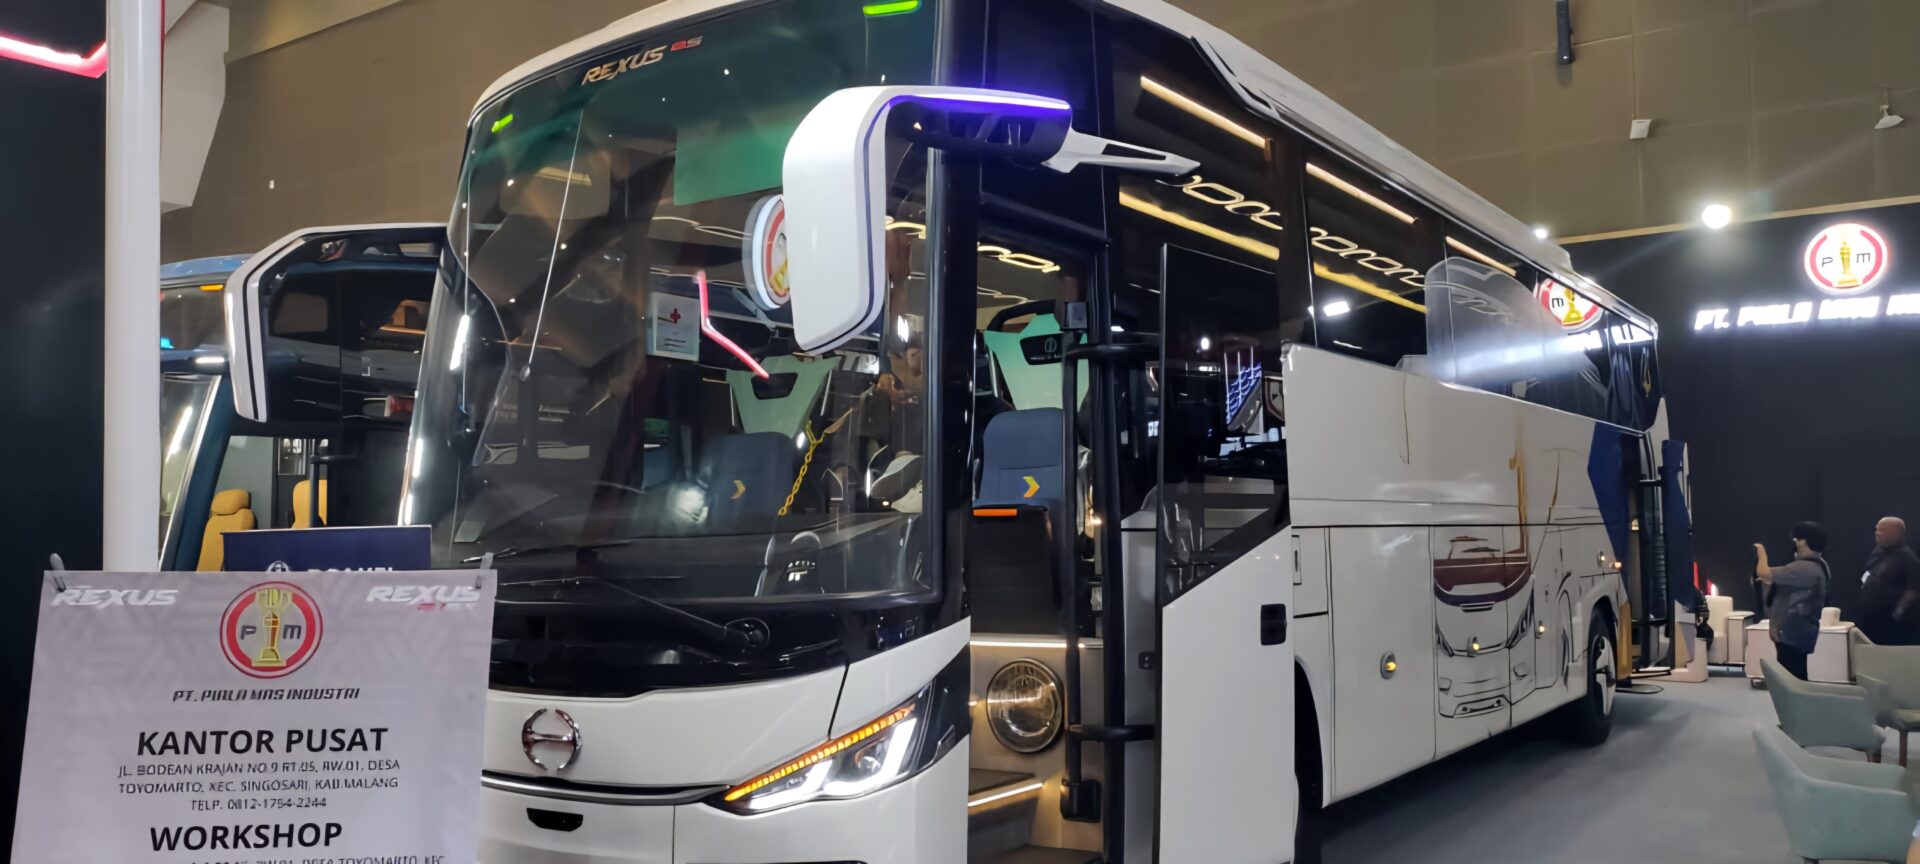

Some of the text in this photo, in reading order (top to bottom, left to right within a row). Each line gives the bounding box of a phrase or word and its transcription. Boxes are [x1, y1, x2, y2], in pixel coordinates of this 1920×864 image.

[581, 45, 668, 86] REXUS
[51, 589, 179, 609] REXUS
[366, 585, 481, 606] REXUS
[240, 625, 256, 640] P
[173, 690, 198, 702] PT.
[286, 688, 360, 700] INDUSTRI
[137, 727, 389, 756] KANTOR PUSAT
[367, 759, 401, 772] DESA
[149, 822, 343, 852] WORKSHOP
